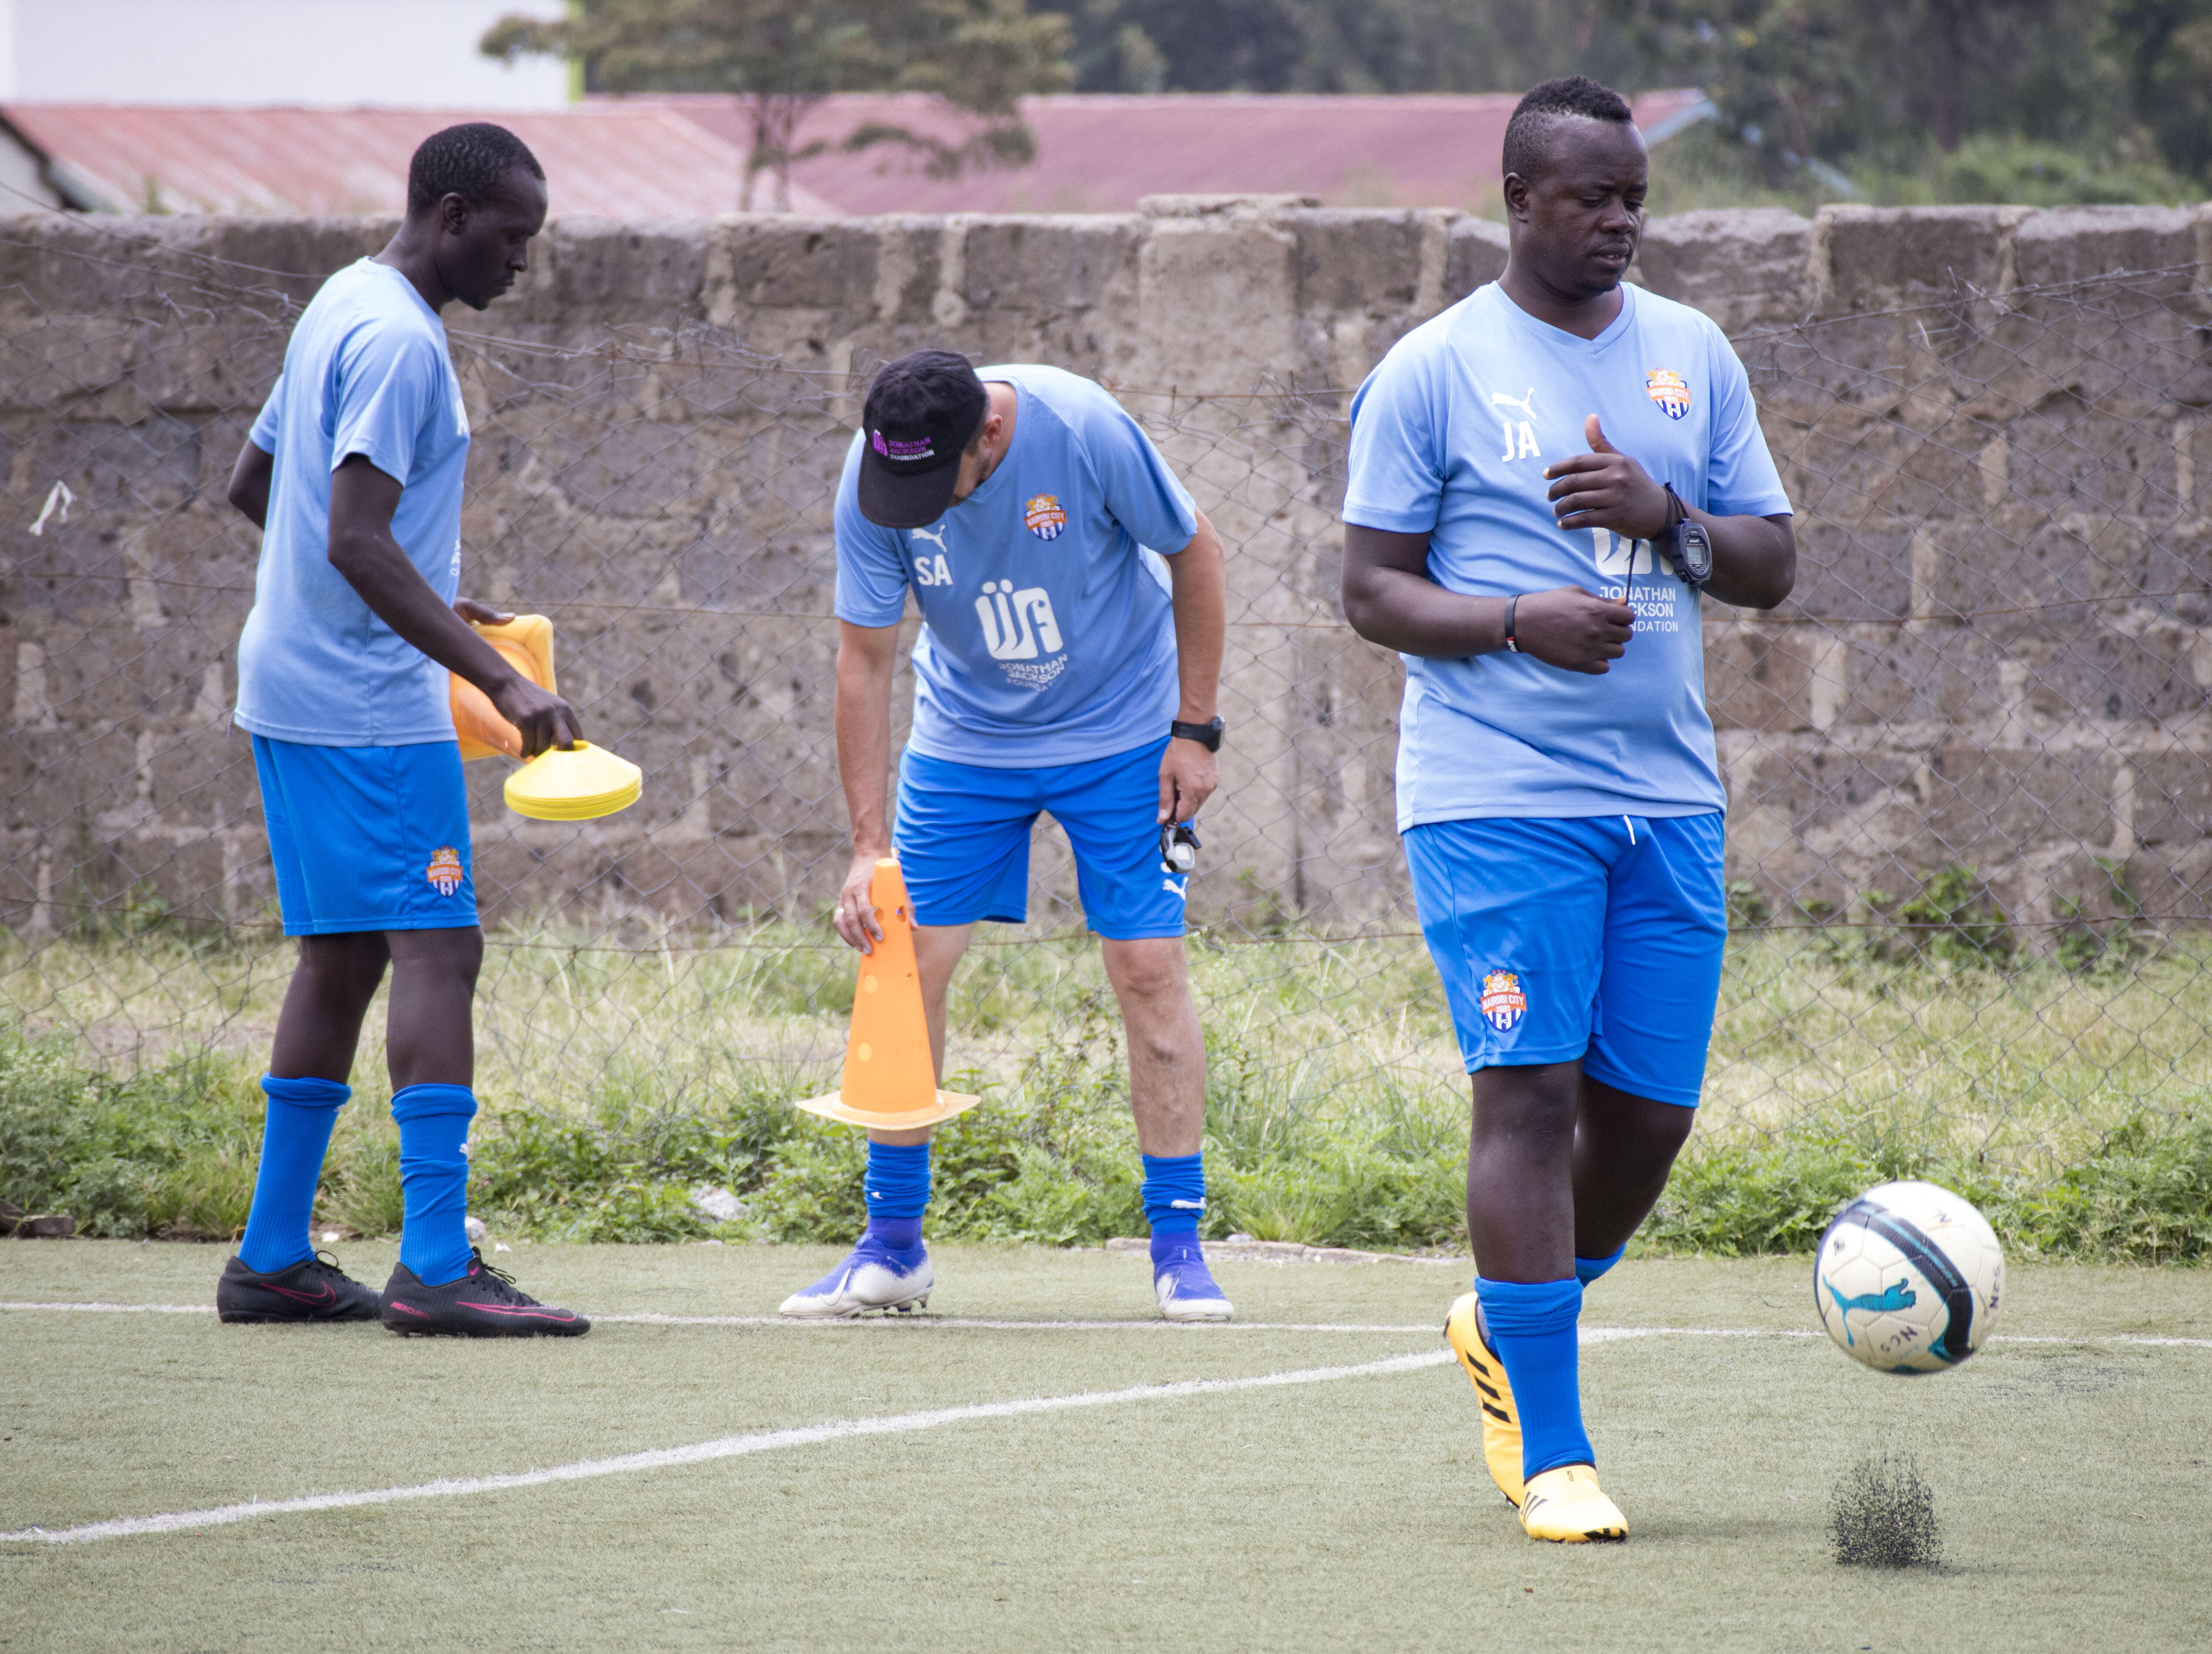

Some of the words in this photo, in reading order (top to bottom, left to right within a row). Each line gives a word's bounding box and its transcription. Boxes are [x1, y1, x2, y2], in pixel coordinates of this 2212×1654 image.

[1674, 388, 1689, 400] CITY
[888, 437, 931, 448] JONATHAN
[1502, 421, 1541, 462] JA
[890, 445, 926, 454] JACKSON
[890, 449, 935, 461] FOUNDATION
[915, 554, 953, 586] SA
[1600, 586, 1676, 601] JONATHAN
[1629, 621, 1679, 632] NDATION
[999, 654, 1067, 675] JONATHAN
[1007, 662, 1065, 684] JACKSON
[1483, 994, 1508, 1010] NAIROBI
[1508, 994, 1524, 1006] CITY
